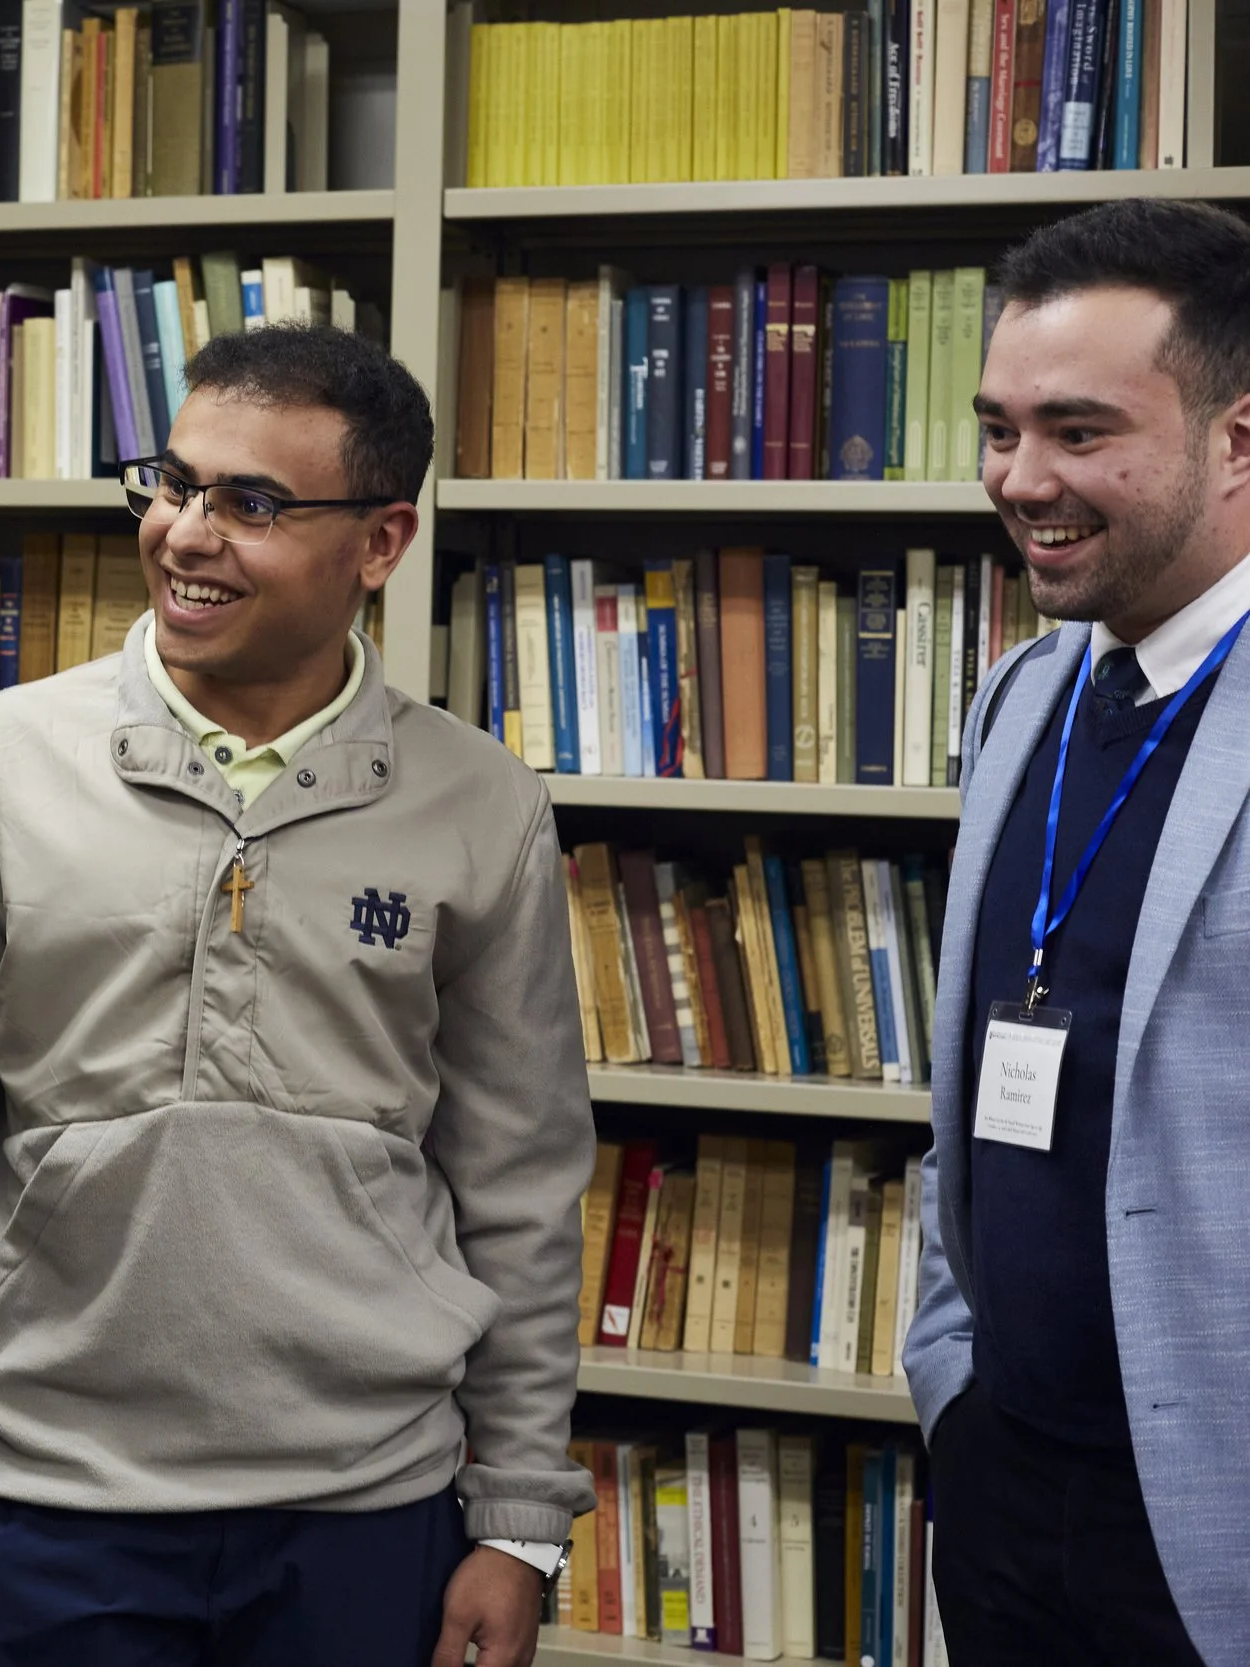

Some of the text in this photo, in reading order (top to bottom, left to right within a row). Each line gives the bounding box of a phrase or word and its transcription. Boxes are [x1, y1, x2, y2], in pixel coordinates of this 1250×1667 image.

[1070, 4, 1086, 85] Imagination
[1083, 25, 1097, 71] Sword
[887, 43, 900, 138] Ace of Freedoms
[995, 14, 1010, 159] Sex and the Marriage Covenant
[917, 602, 931, 668] Cassirer
[843, 885, 867, 955] PROBLEM
[853, 968, 879, 1069] UNIVERSALS
[1000, 1085, 1031, 1104] Ramirez
[1001, 1061, 1037, 1081] Nicholas
[692, 1475, 705, 1605] THE ETHICAL DEMAND
